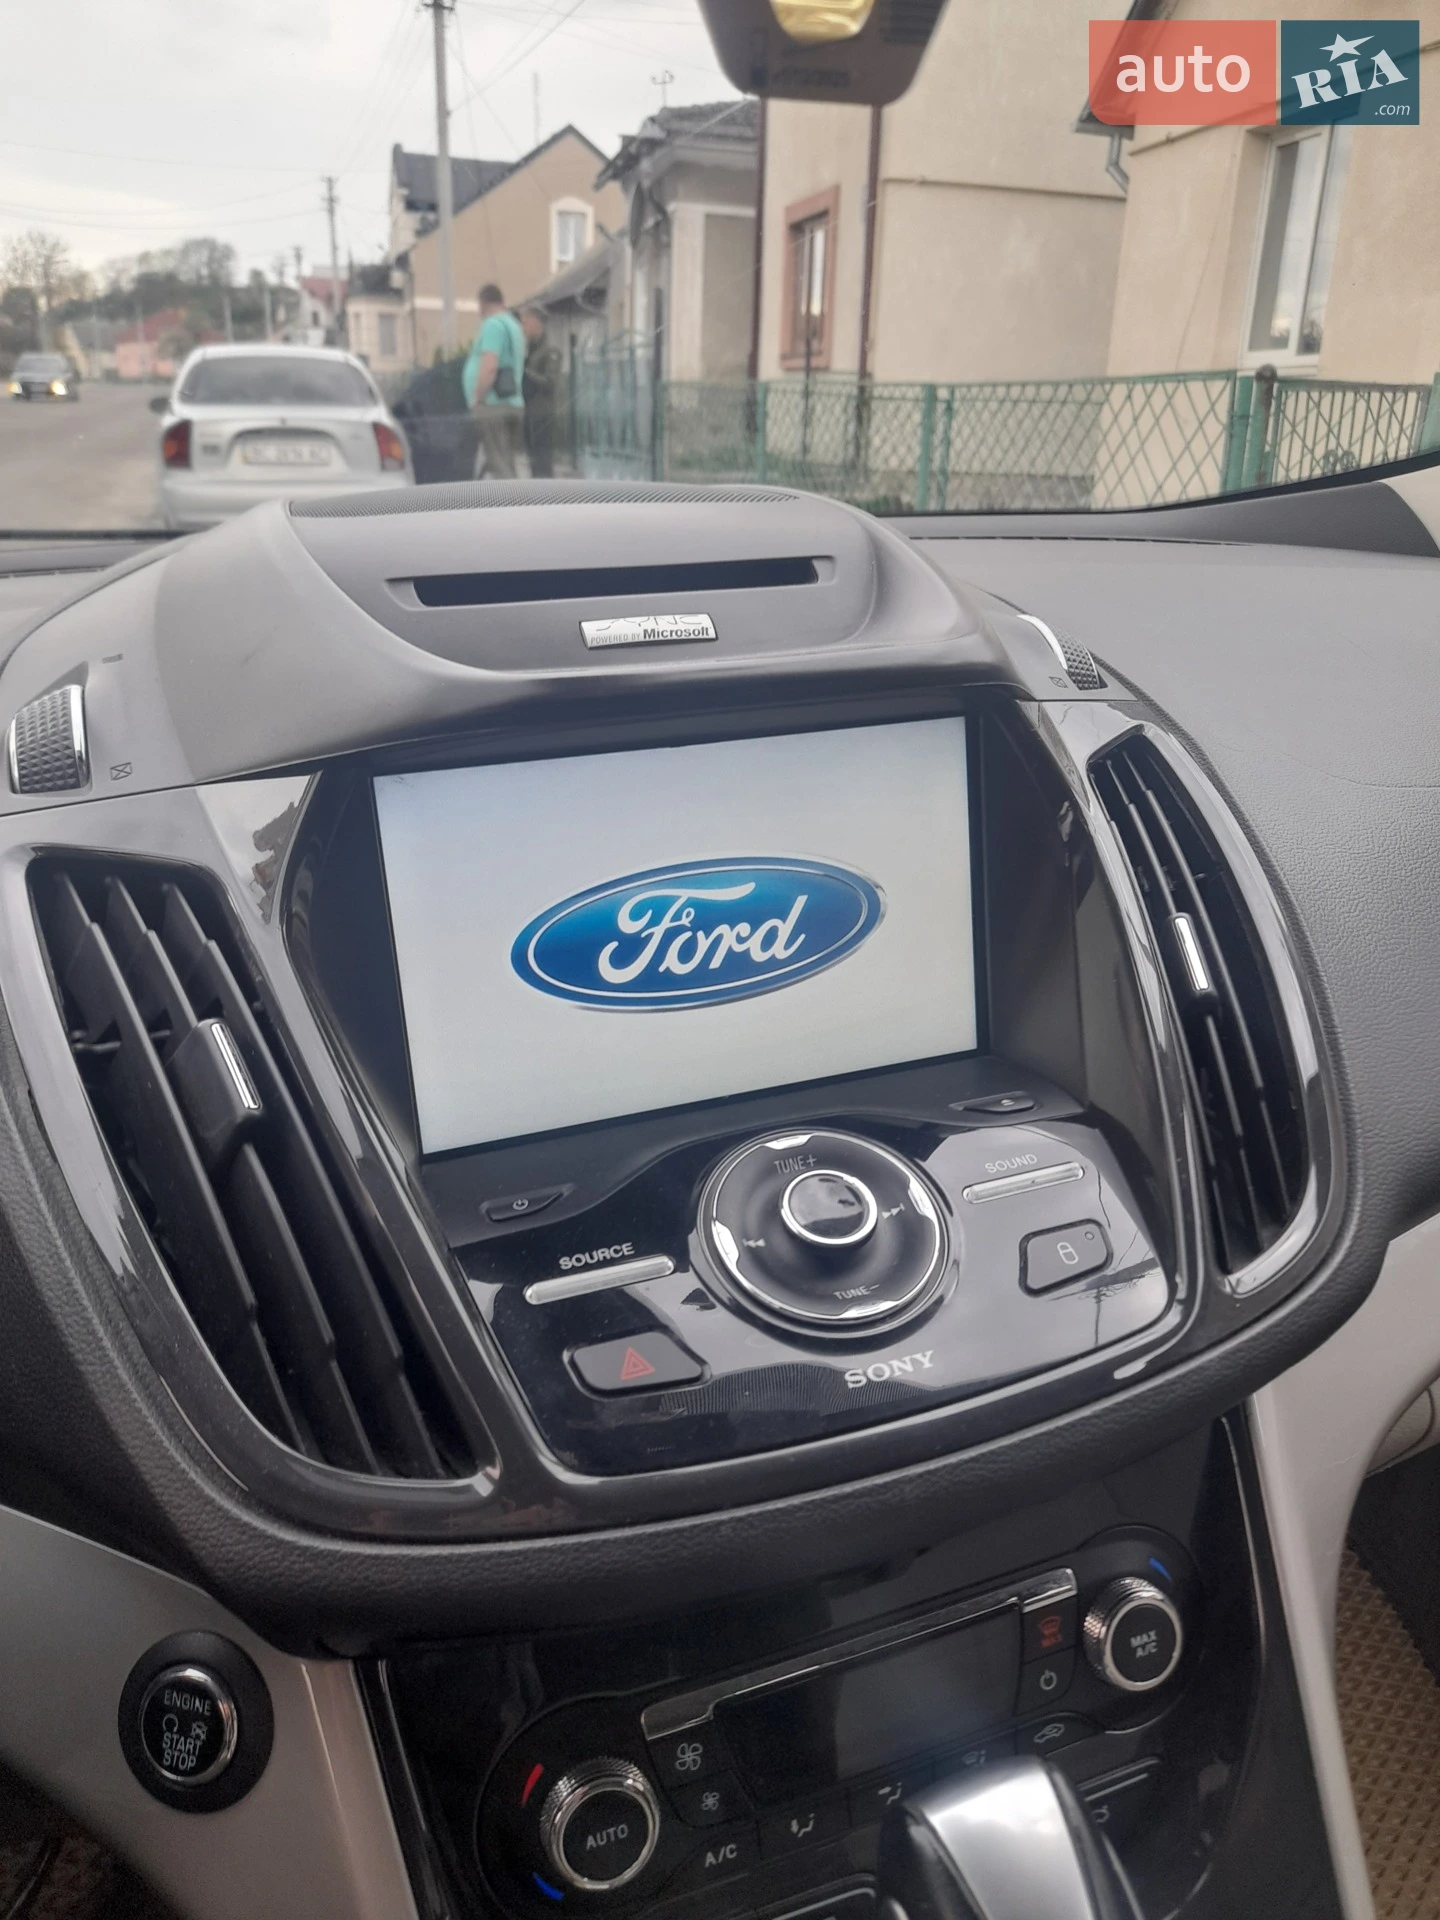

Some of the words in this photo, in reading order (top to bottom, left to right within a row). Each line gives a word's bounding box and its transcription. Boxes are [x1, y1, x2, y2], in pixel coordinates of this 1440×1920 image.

[590, 633, 629, 646] POWERED
[631, 632, 641, 641] BY
[643, 626, 710, 640] Microsoft
[597, 881, 809, 985] Ford
[984, 1153, 1038, 1174] SOUND
[558, 1241, 636, 1271] SOURCE
[843, 1349, 935, 1390] SONY
[1129, 1629, 1159, 1649] MAX
[1135, 1641, 1160, 1660] A/C
[163, 1688, 213, 1717] ENGINE
[162, 1731, 204, 1757] START
[162, 1748, 197, 1772] STOP
[585, 1823, 629, 1851] AUTO
[704, 1843, 739, 1869] A/C
